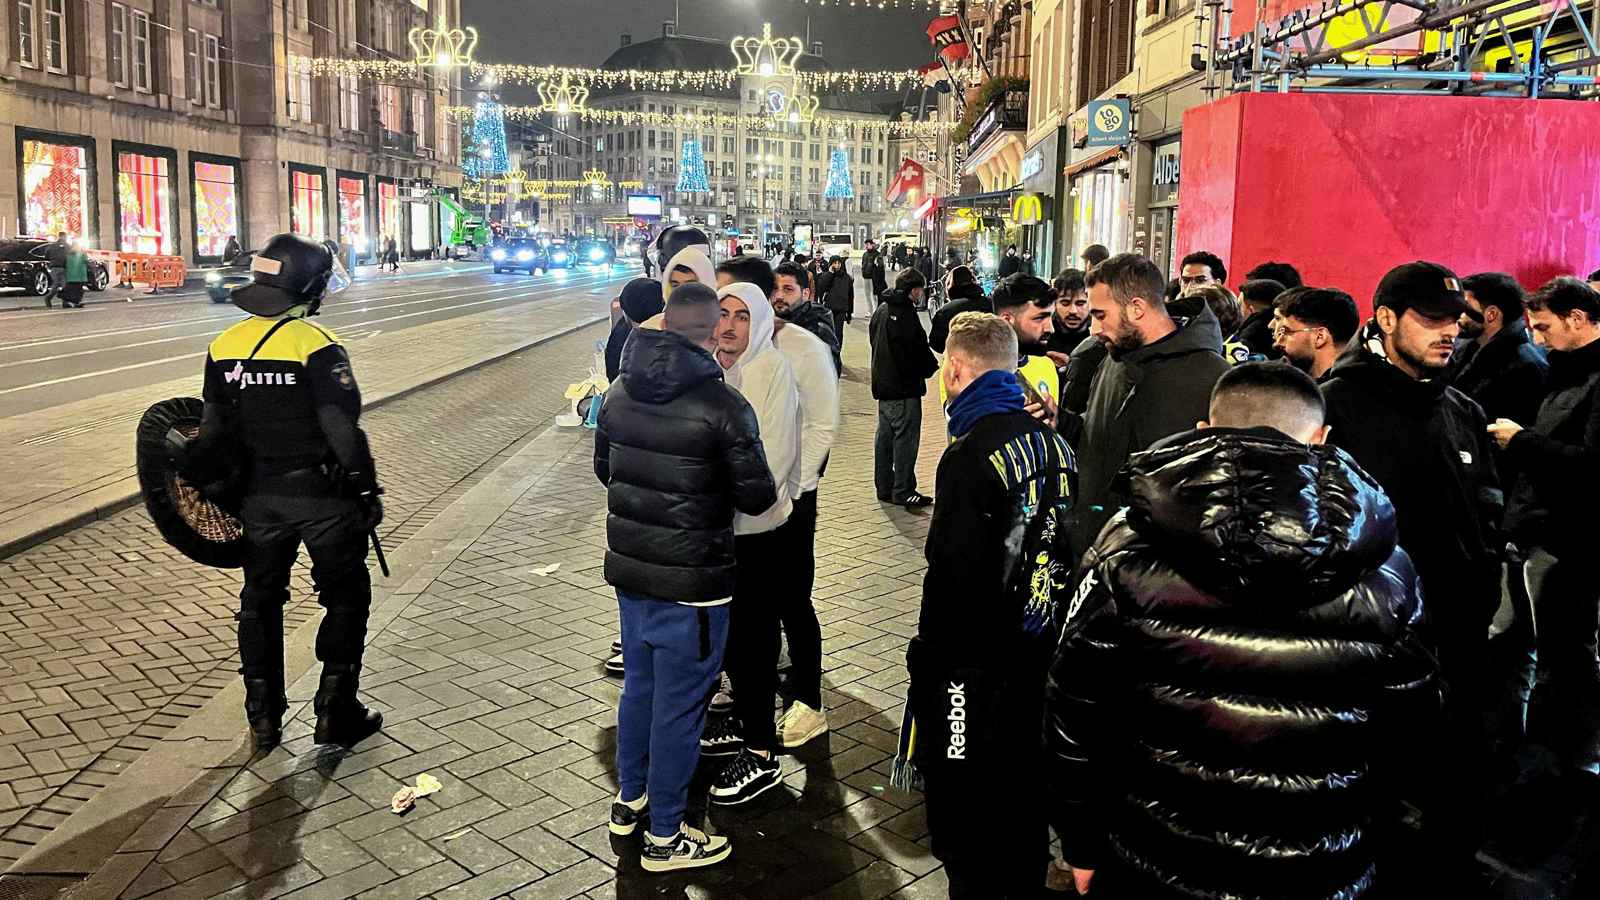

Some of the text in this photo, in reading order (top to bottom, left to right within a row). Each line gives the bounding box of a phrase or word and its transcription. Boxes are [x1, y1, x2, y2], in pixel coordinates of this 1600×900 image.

[1100, 108, 1114, 120] to
[1105, 115, 1120, 131] go
[224, 368, 296, 387] LITIE
[947, 681, 966, 759] Reebok
